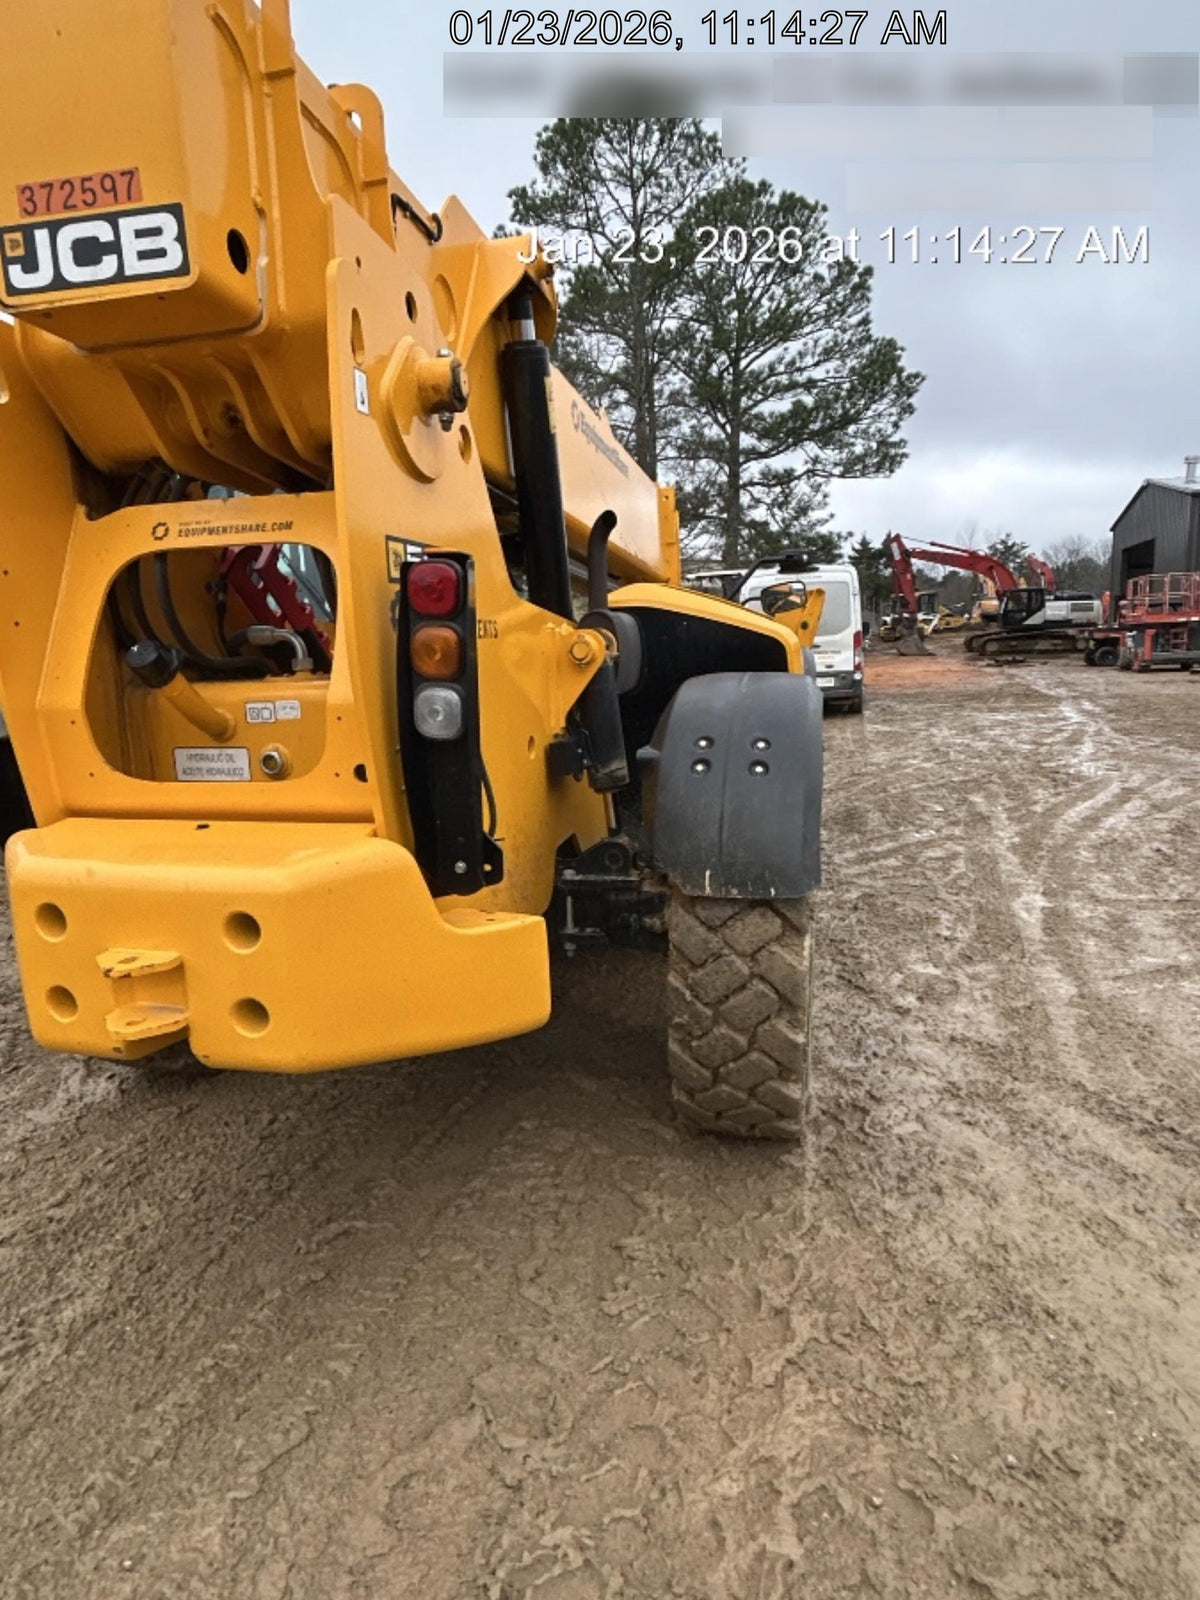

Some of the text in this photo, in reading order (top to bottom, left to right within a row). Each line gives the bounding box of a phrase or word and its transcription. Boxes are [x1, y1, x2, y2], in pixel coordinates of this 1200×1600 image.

[20, 170, 136, 216] 372597
[7, 212, 184, 289] JCB
[177, 520, 294, 538] EQUIPMENTSHARE.COM
